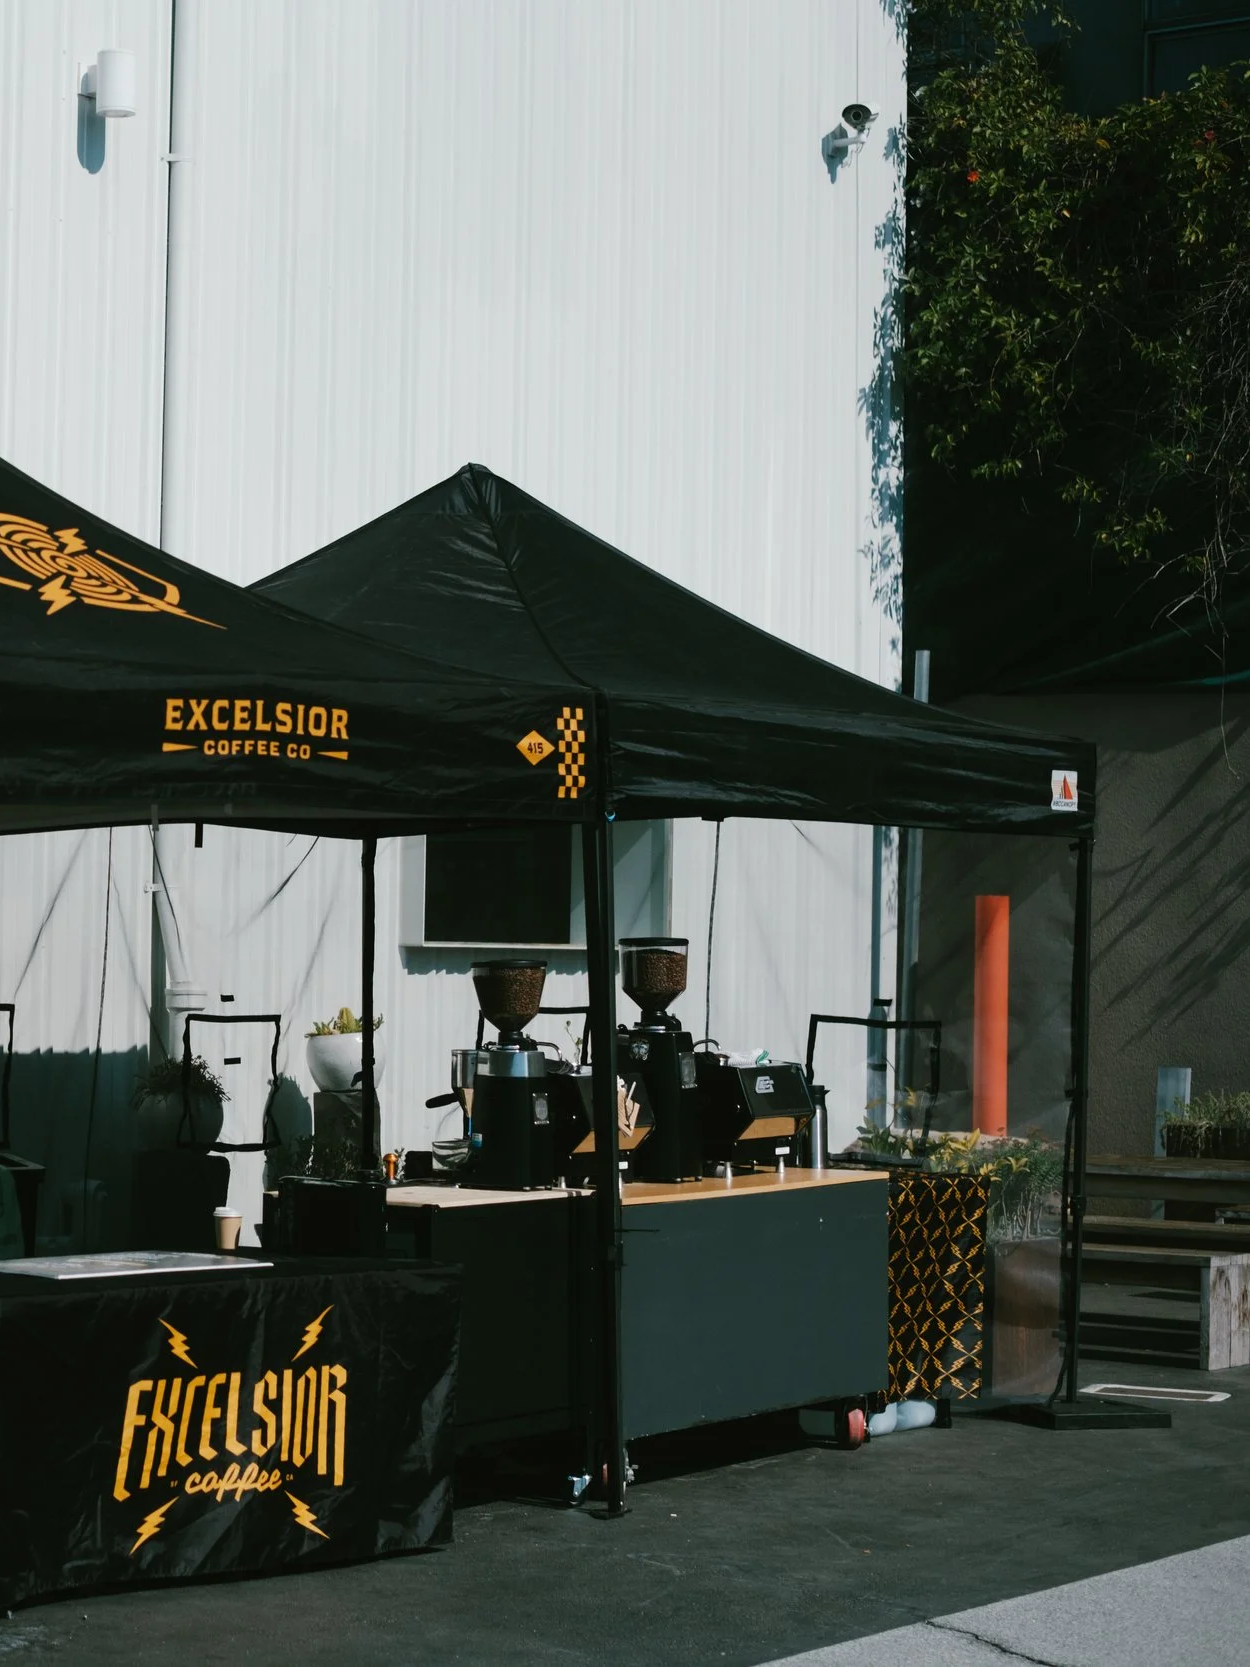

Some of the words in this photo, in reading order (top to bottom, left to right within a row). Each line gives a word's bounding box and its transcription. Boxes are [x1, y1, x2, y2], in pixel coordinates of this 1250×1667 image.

[164, 698, 350, 740] EXCELSIOR
[203, 740, 281, 757] COFFEE
[286, 743, 311, 759] CO
[527, 742, 544, 754] 415
[113, 1363, 348, 1502] EXCELSIOR
[184, 1462, 282, 1502] coffee
